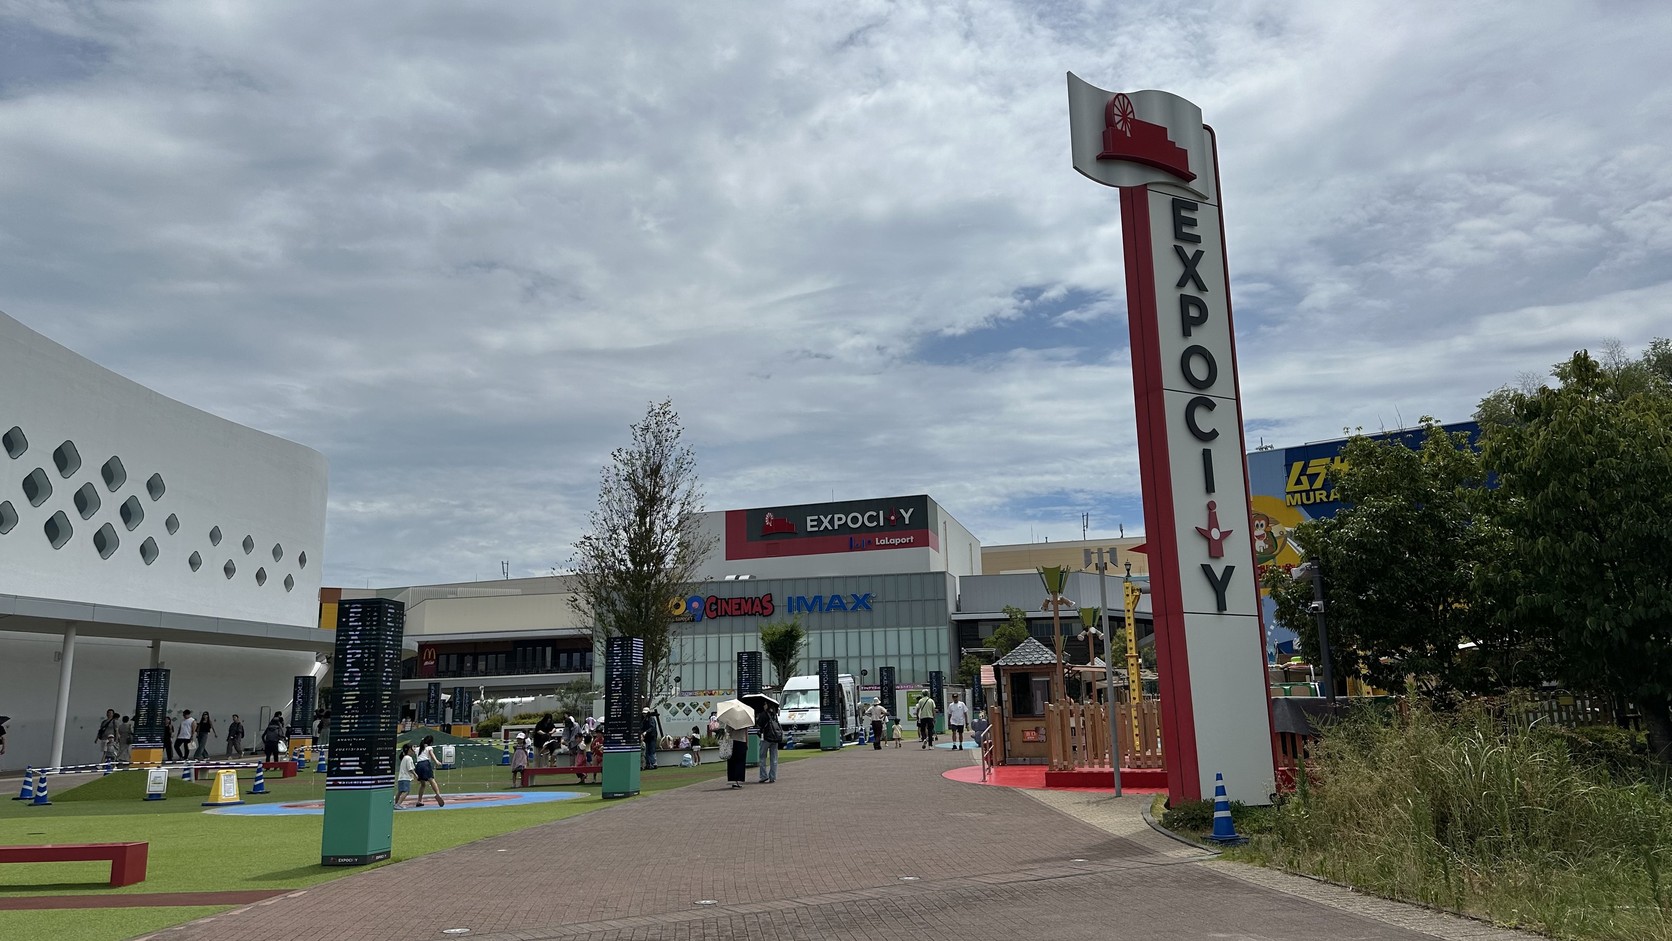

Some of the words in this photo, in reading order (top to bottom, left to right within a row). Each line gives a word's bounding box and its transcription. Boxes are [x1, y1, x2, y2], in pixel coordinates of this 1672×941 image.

[875, 535, 915, 546] LaLaport
[705, 593, 775, 619] CINEMAS
[787, 593, 872, 614] IMAX
